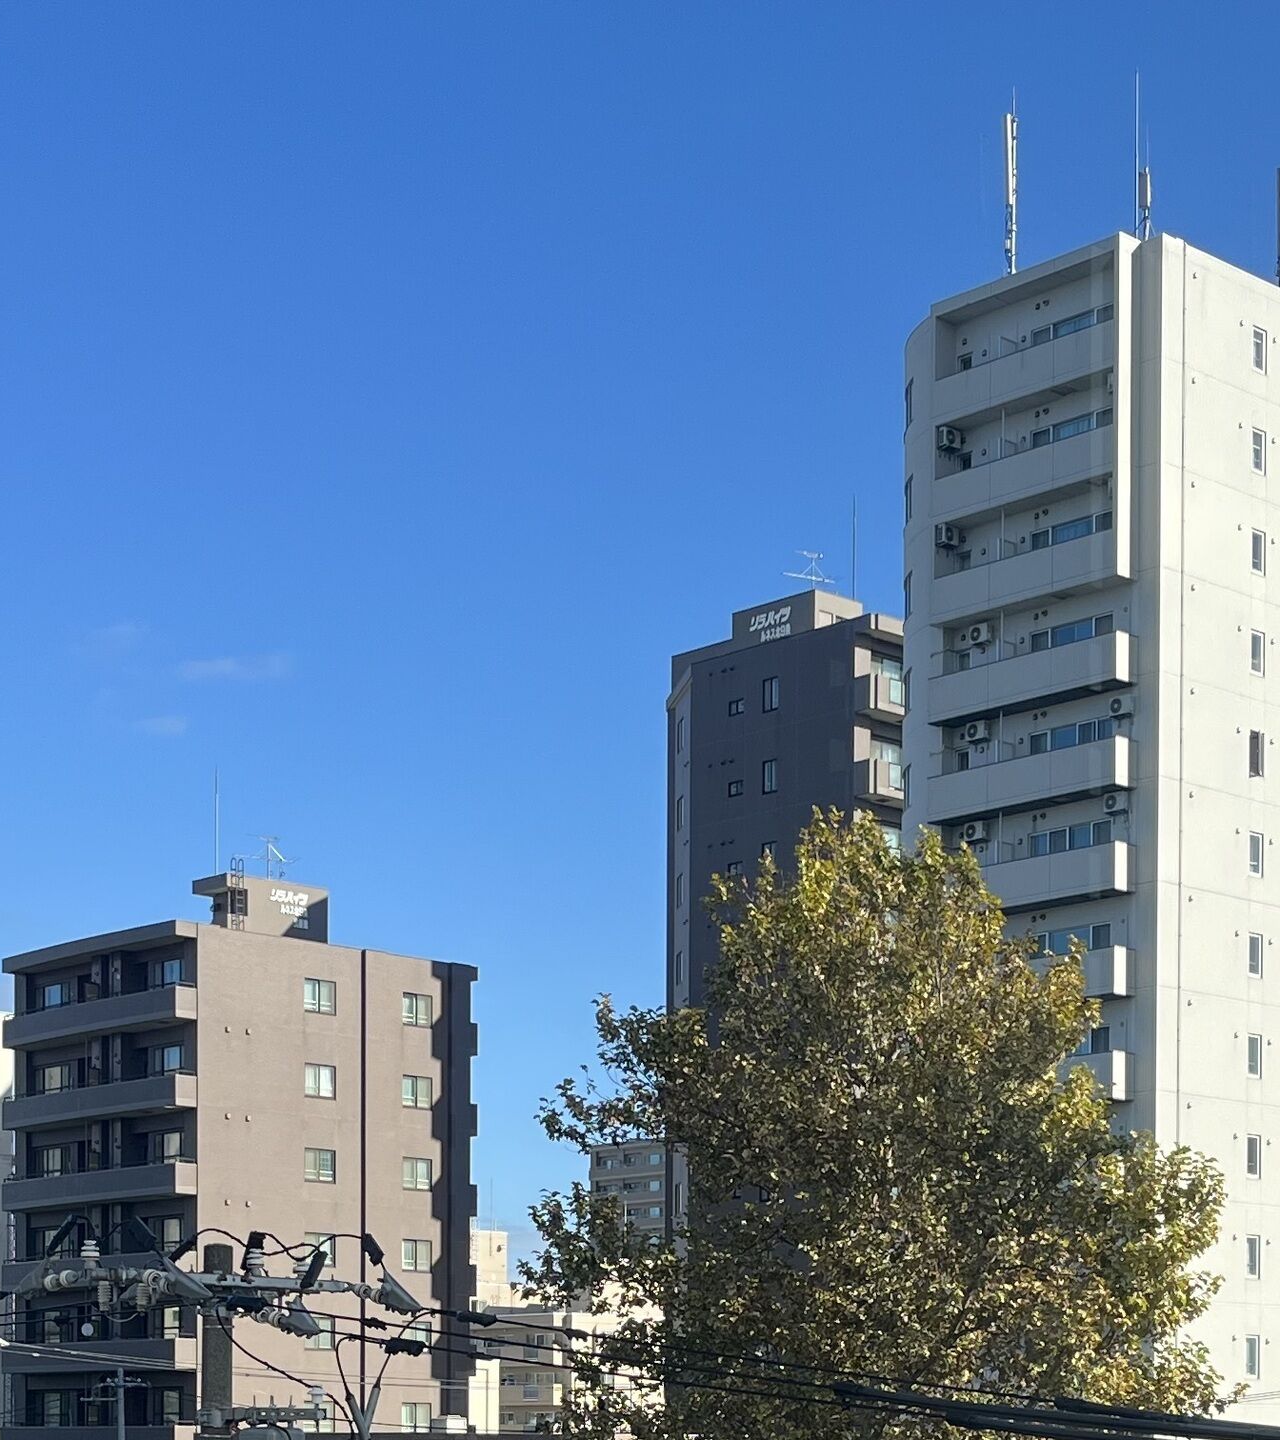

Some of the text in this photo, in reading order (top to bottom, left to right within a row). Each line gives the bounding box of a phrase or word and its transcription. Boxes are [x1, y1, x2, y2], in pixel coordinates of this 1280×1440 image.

[749, 606, 791, 632] リラハイツ
